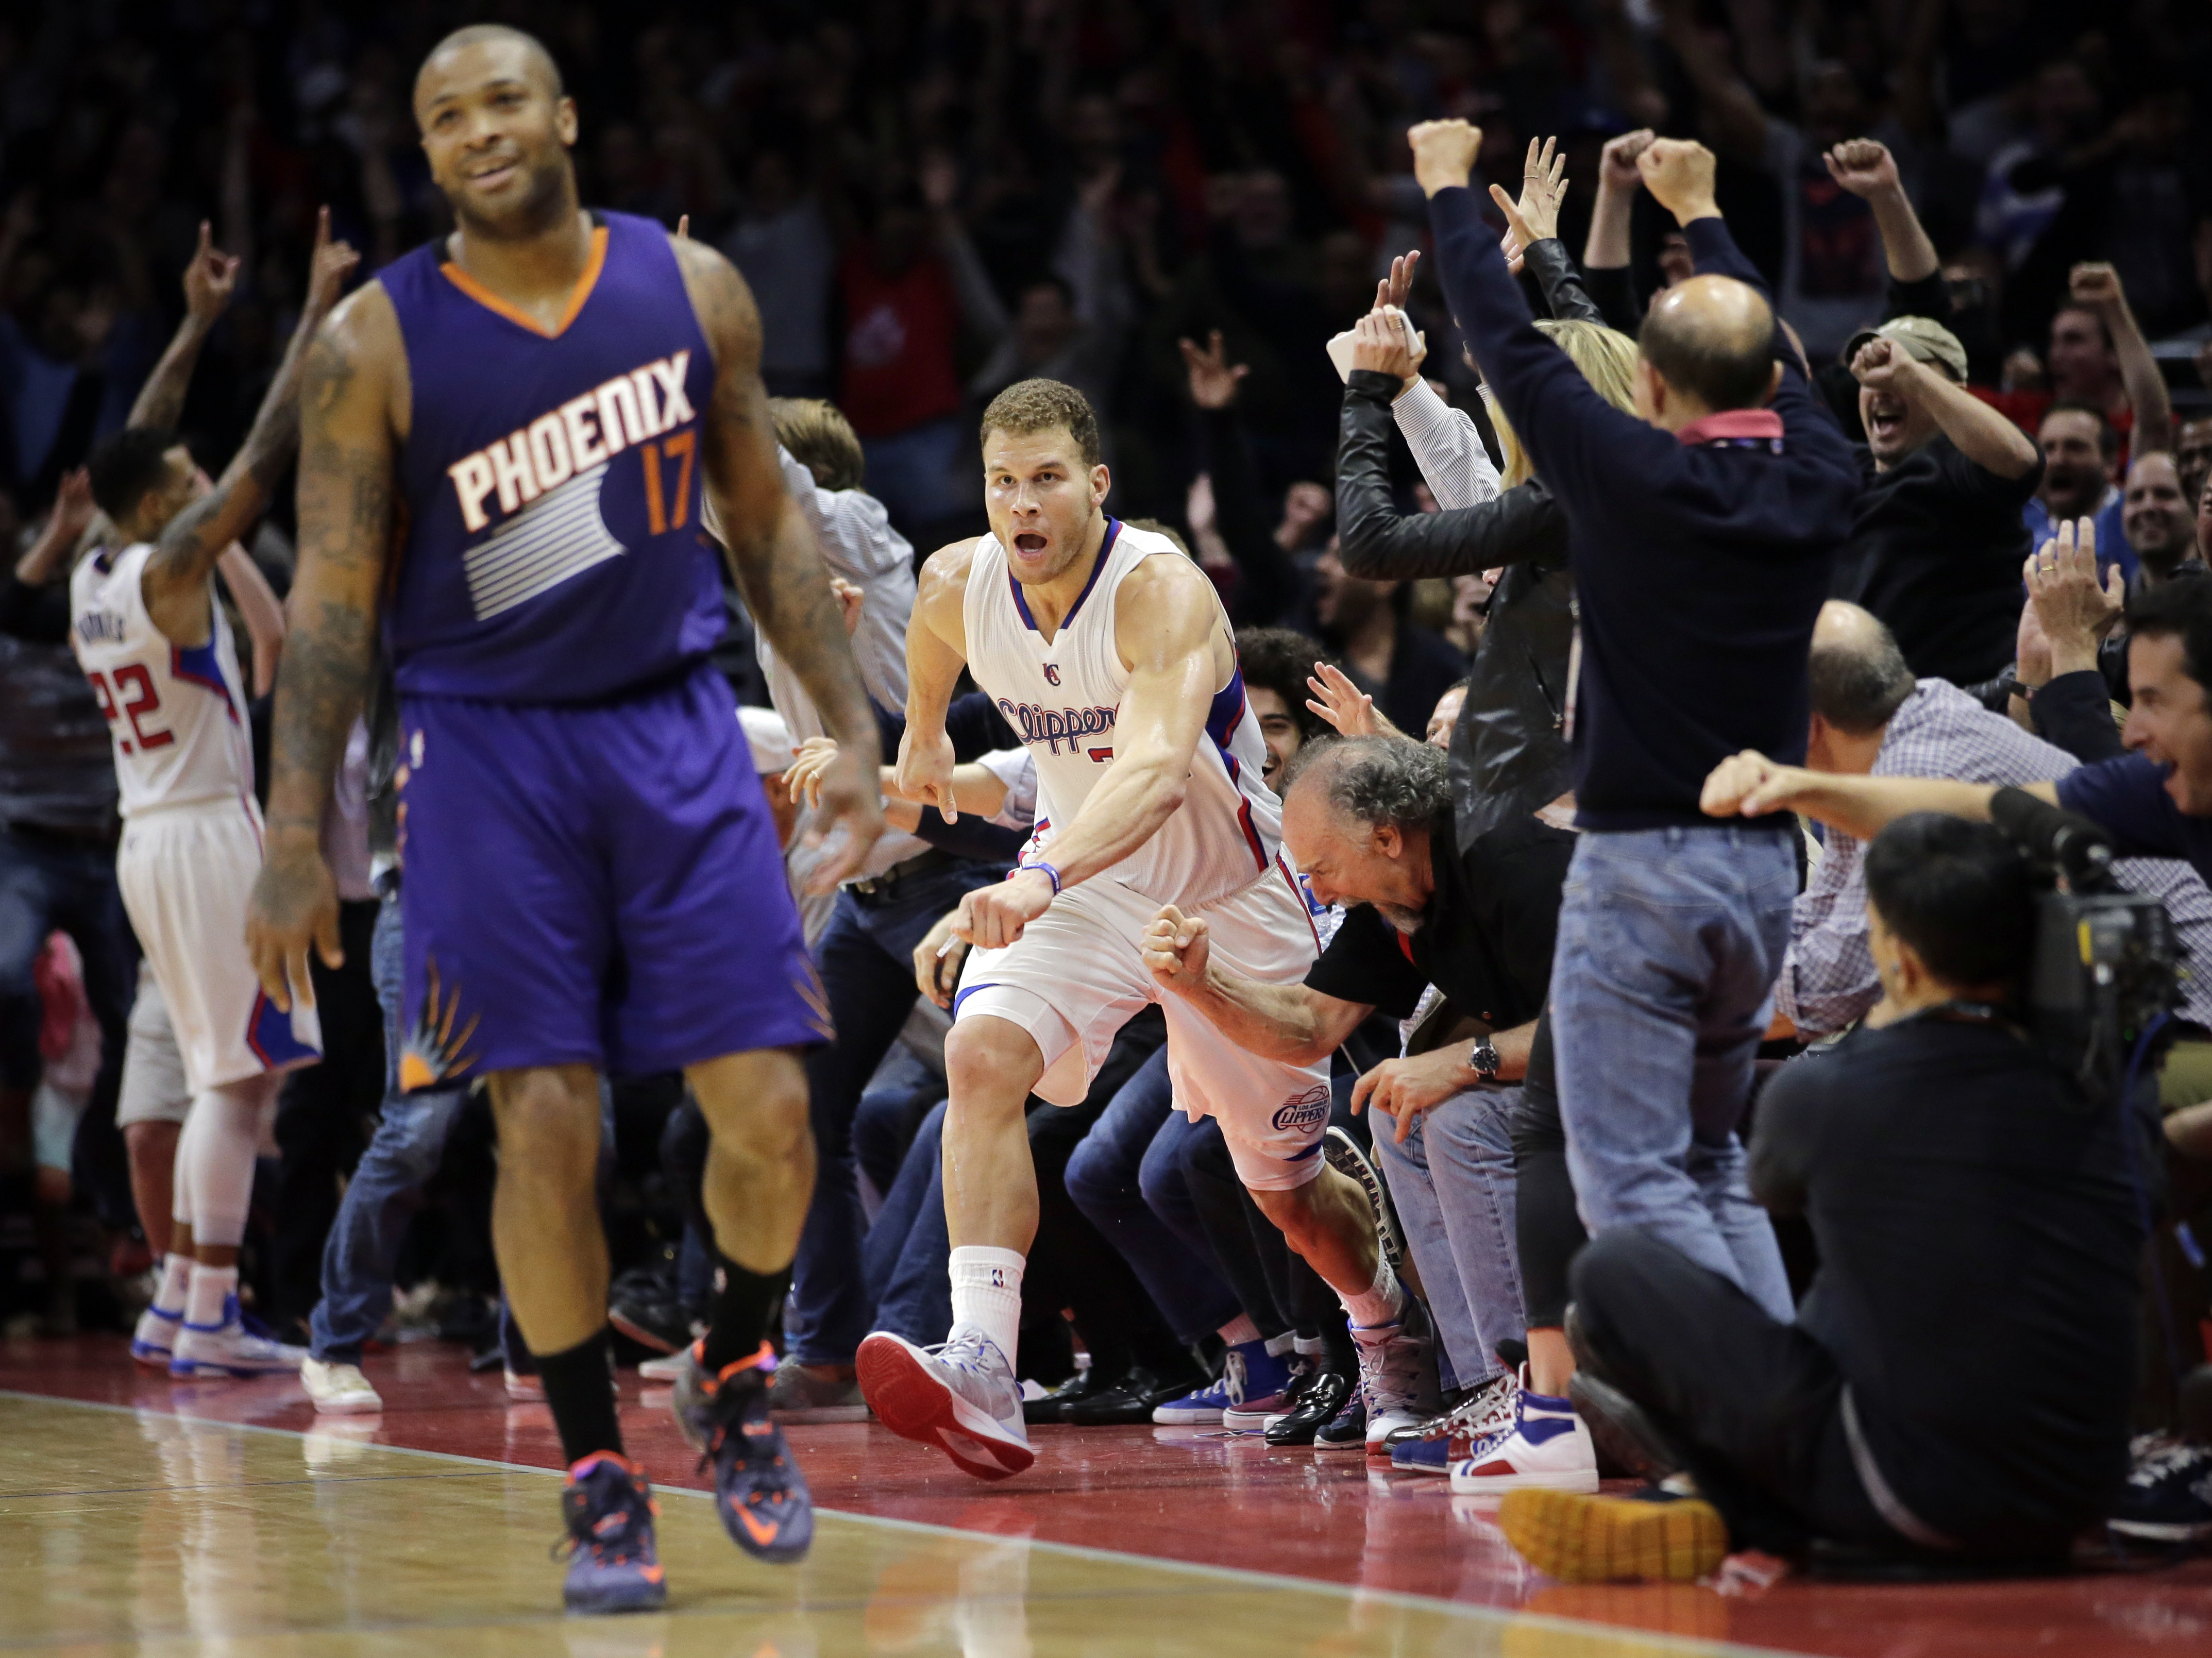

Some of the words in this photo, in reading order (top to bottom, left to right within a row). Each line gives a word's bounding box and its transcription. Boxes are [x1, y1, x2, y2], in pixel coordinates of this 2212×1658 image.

[447, 348, 696, 533] PHOENIX
[641, 430, 696, 535] 17
[997, 698, 1120, 756] Clipper
[1272, 1105, 1327, 1130] CLIPPERS
